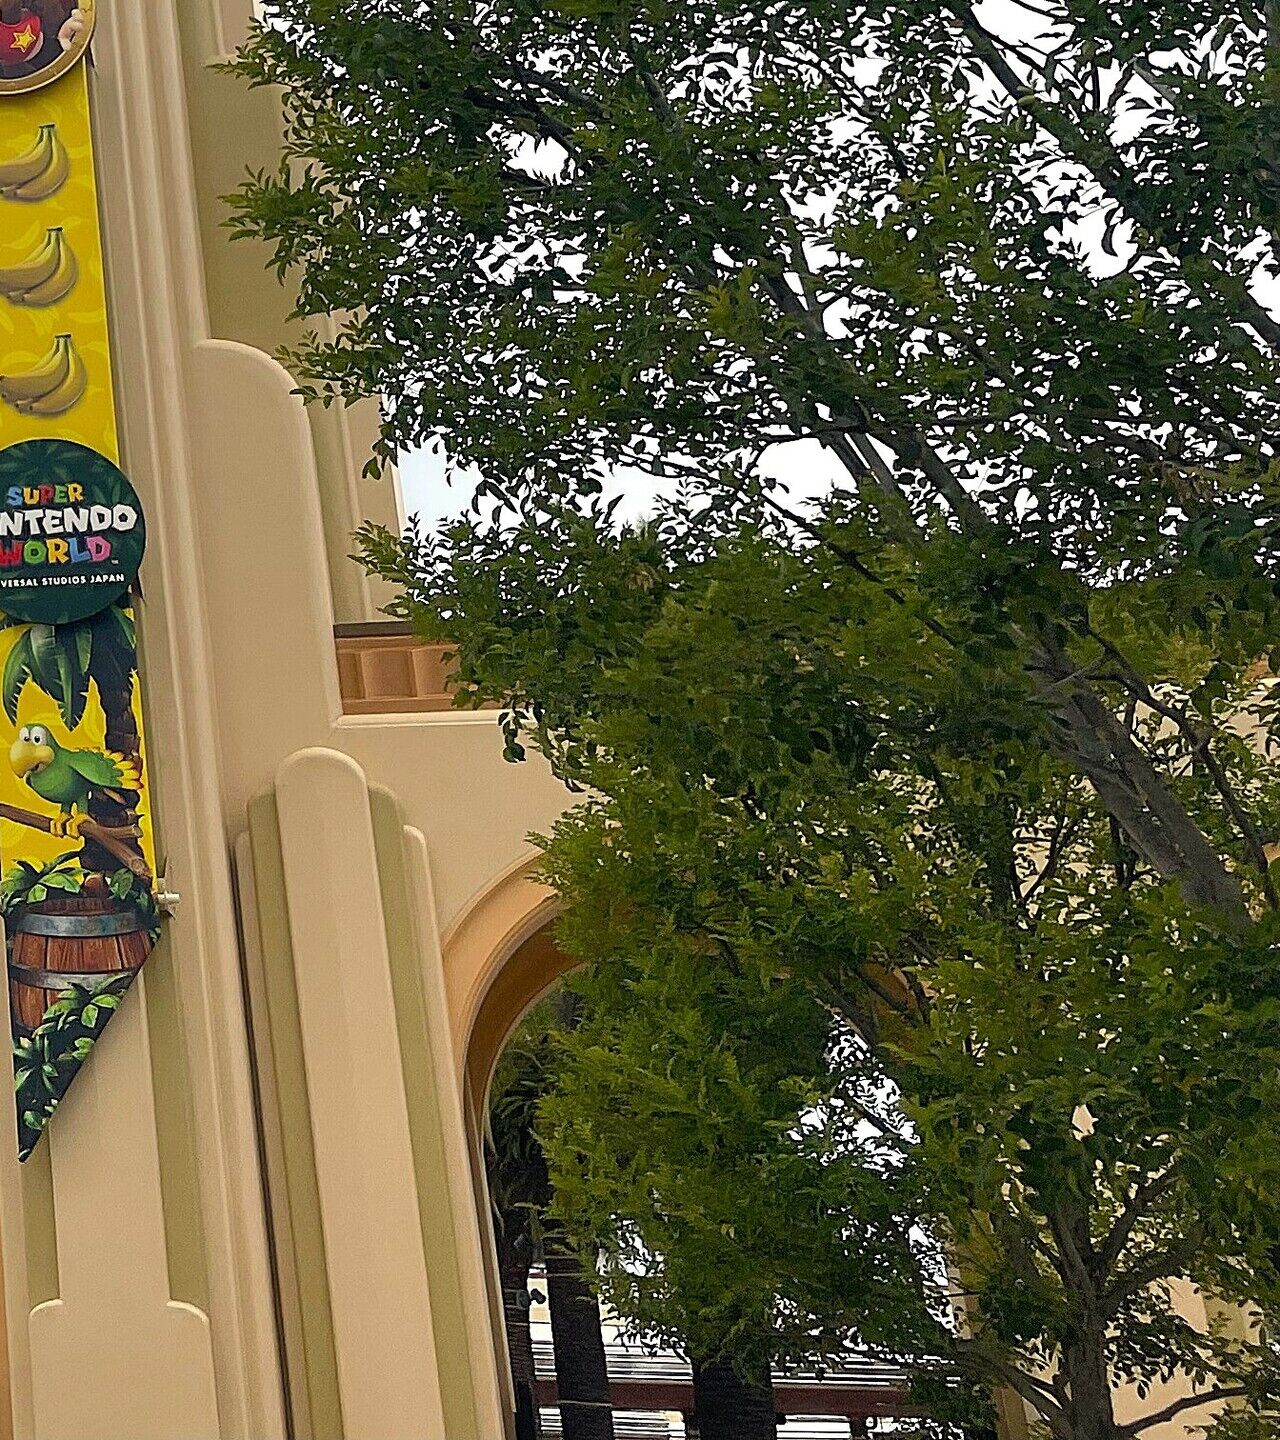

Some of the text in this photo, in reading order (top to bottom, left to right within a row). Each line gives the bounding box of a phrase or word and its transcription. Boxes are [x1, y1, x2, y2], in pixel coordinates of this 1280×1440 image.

[6, 482, 83, 506] SUPER
[42, 575, 87, 586] STUDIOS
[90, 573, 125, 583] JAPAN
